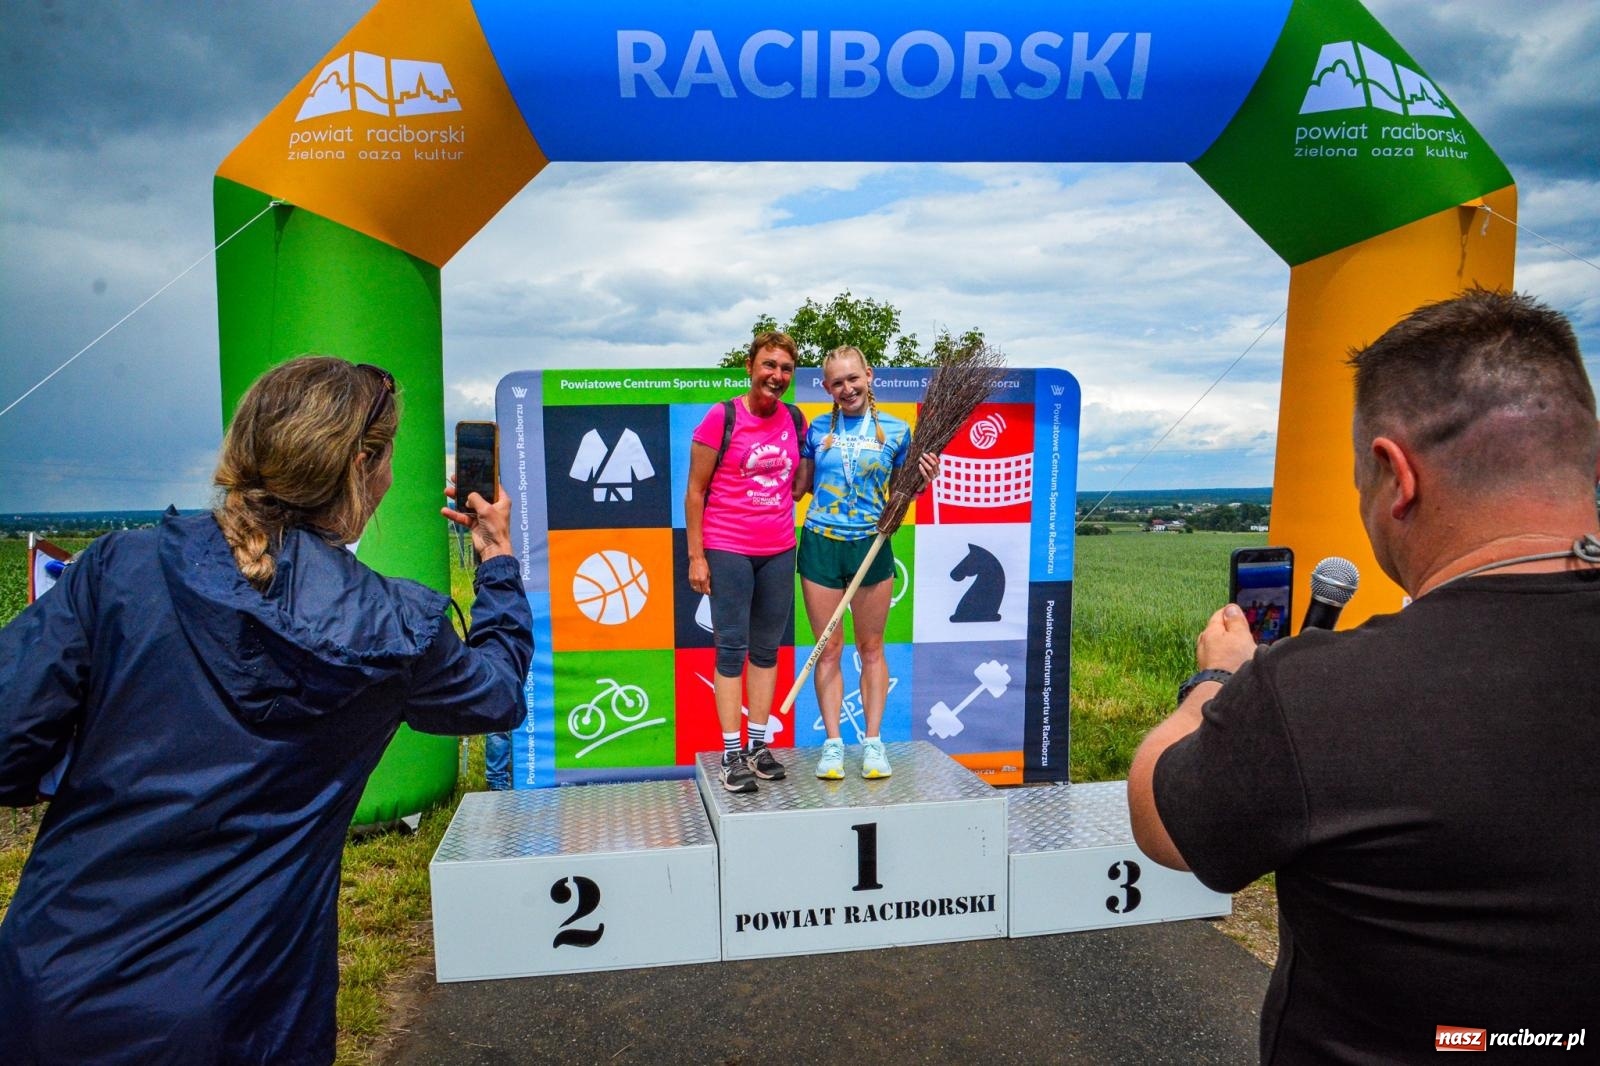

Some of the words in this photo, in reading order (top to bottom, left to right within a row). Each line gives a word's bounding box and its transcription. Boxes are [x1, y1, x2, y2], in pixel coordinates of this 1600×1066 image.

[616, 29, 1152, 100] RACIBORSKI
[289, 124, 353, 148] powiat
[366, 125, 465, 143] raciborski
[1295, 121, 1368, 144] powiat
[1381, 122, 1466, 145] raciborski
[288, 149, 345, 160] zielona
[358, 149, 401, 160] oaza
[414, 148, 464, 160] kultur
[1294, 145, 1357, 157] zielona
[1371, 146, 1414, 157] oaza
[1426, 145, 1469, 159] kultur
[560, 378, 622, 390] Powiatowe
[623, 378, 671, 389] Centrum
[673, 377, 710, 391] Sportu
[712, 380, 721, 388] w
[873, 377, 919, 388] Centrum
[515, 404, 525, 449] Raciborzu
[1052, 403, 1062, 452] Powiatowe
[519, 450, 526, 459] w
[1050, 453, 1060, 490] Centrum
[518, 460, 528, 491] Sportu
[520, 492, 529, 531] Centrum
[1049, 491, 1059, 521] Sportu
[1049, 522, 1056, 530] w
[521, 532, 531, 580] Powiatowe
[1047, 531, 1057, 574] Raciborzu
[1045, 600, 1055, 648] Powiatowe
[1043, 649, 1053, 686] Centrum
[525, 692, 535, 733] Centrum
[1042, 687, 1052, 715] Sportu
[1043, 716, 1050, 724] w
[526, 734, 536, 784] Powiatowe
[1041, 725, 1051, 767] Raciborzu
[851, 822, 883, 891] 1
[1105, 860, 1142, 914] 3
[550, 876, 604, 949] 2
[735, 907, 836, 932] POWIAT
[844, 894, 996, 924] RACIBORSKI
